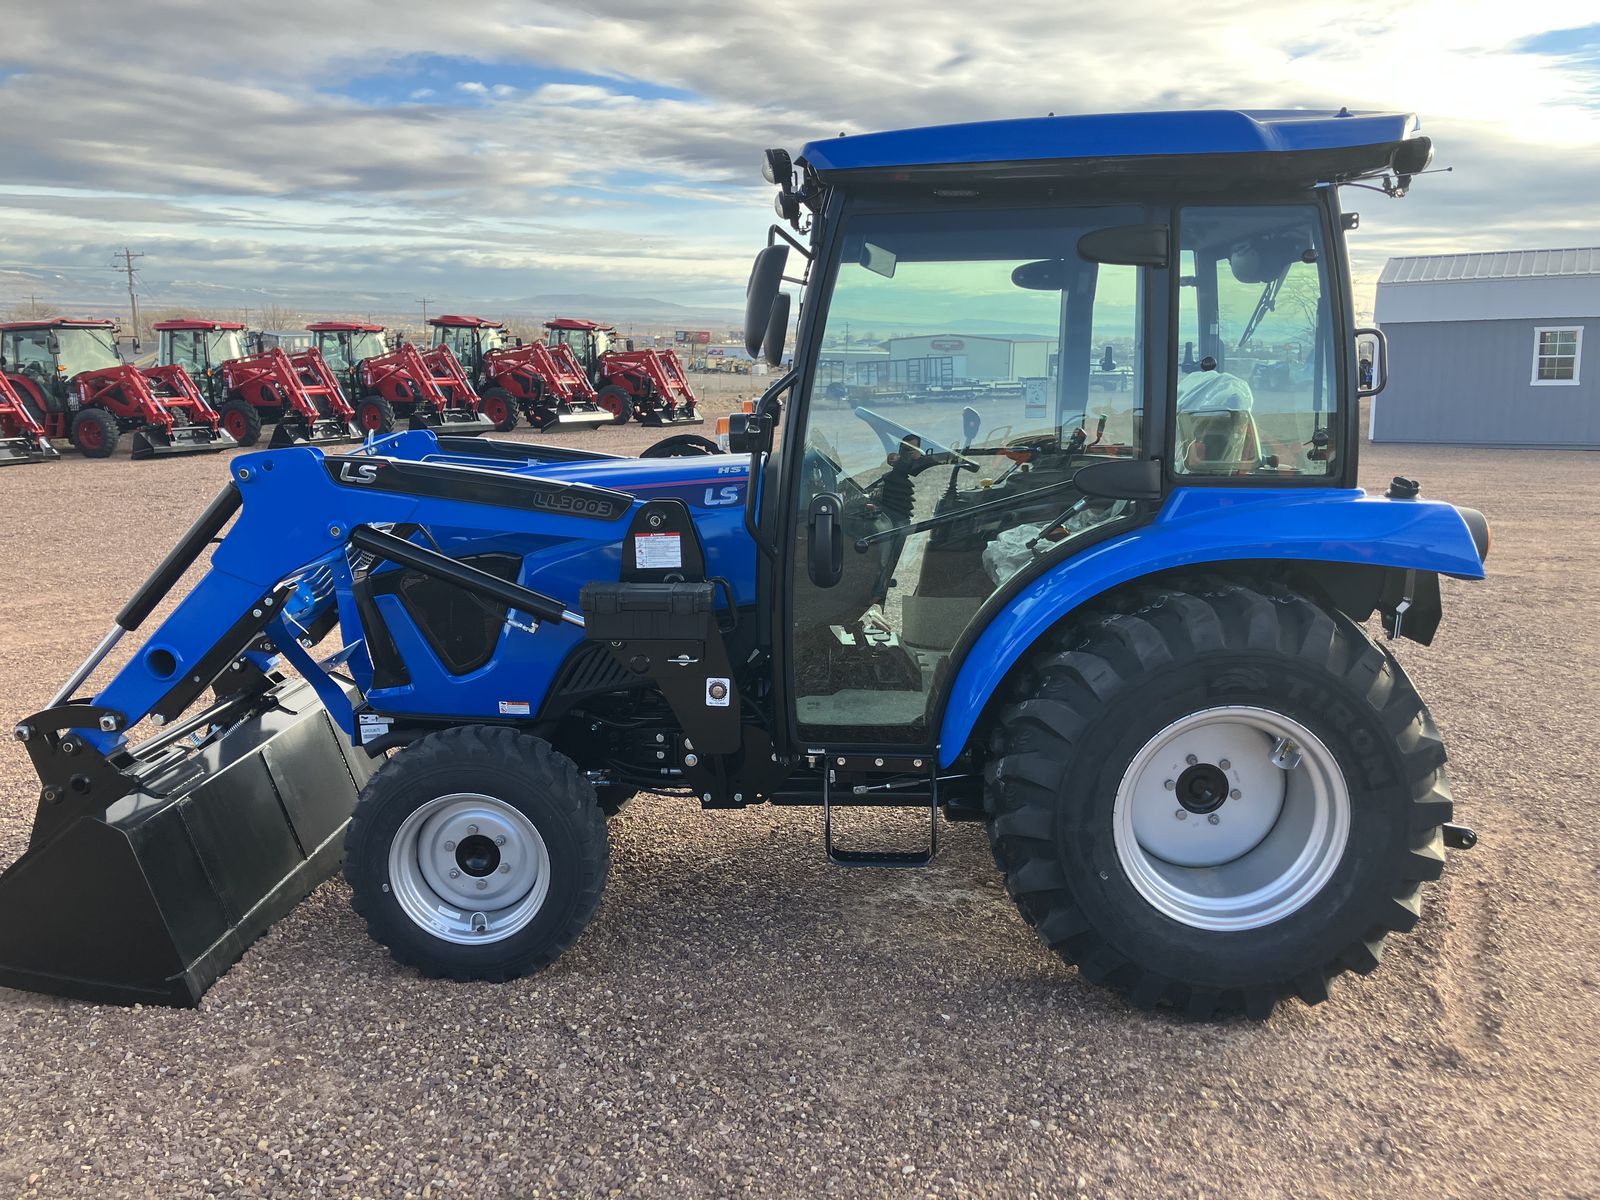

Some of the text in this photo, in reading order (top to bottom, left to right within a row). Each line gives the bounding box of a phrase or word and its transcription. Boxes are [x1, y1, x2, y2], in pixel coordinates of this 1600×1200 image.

[339, 461, 378, 484] LS
[533, 491, 613, 517] LL3003
[704, 486, 738, 506] LS
